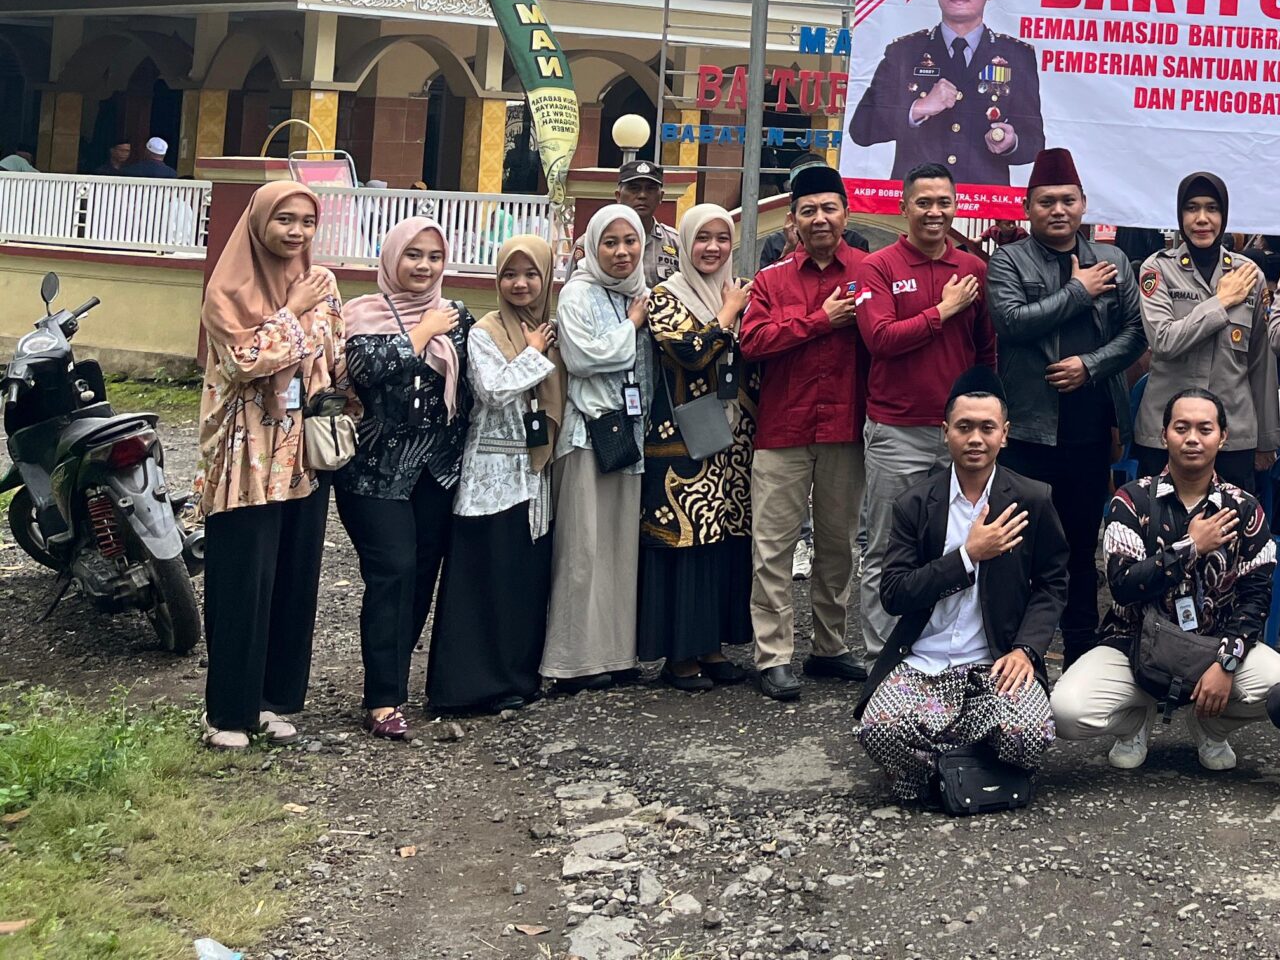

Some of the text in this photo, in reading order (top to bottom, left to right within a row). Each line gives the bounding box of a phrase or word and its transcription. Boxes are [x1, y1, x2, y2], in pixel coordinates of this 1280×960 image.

[1019, 16, 1098, 42] REMAJA
[1103, 19, 1179, 46] MASJID
[1041, 50, 1158, 77] PEMBERIAN
[1162, 55, 1258, 82] SANTUAN
[1133, 86, 1175, 110] DAN
[854, 188, 876, 196] AKBP
[878, 189, 904, 197] BOBBY
